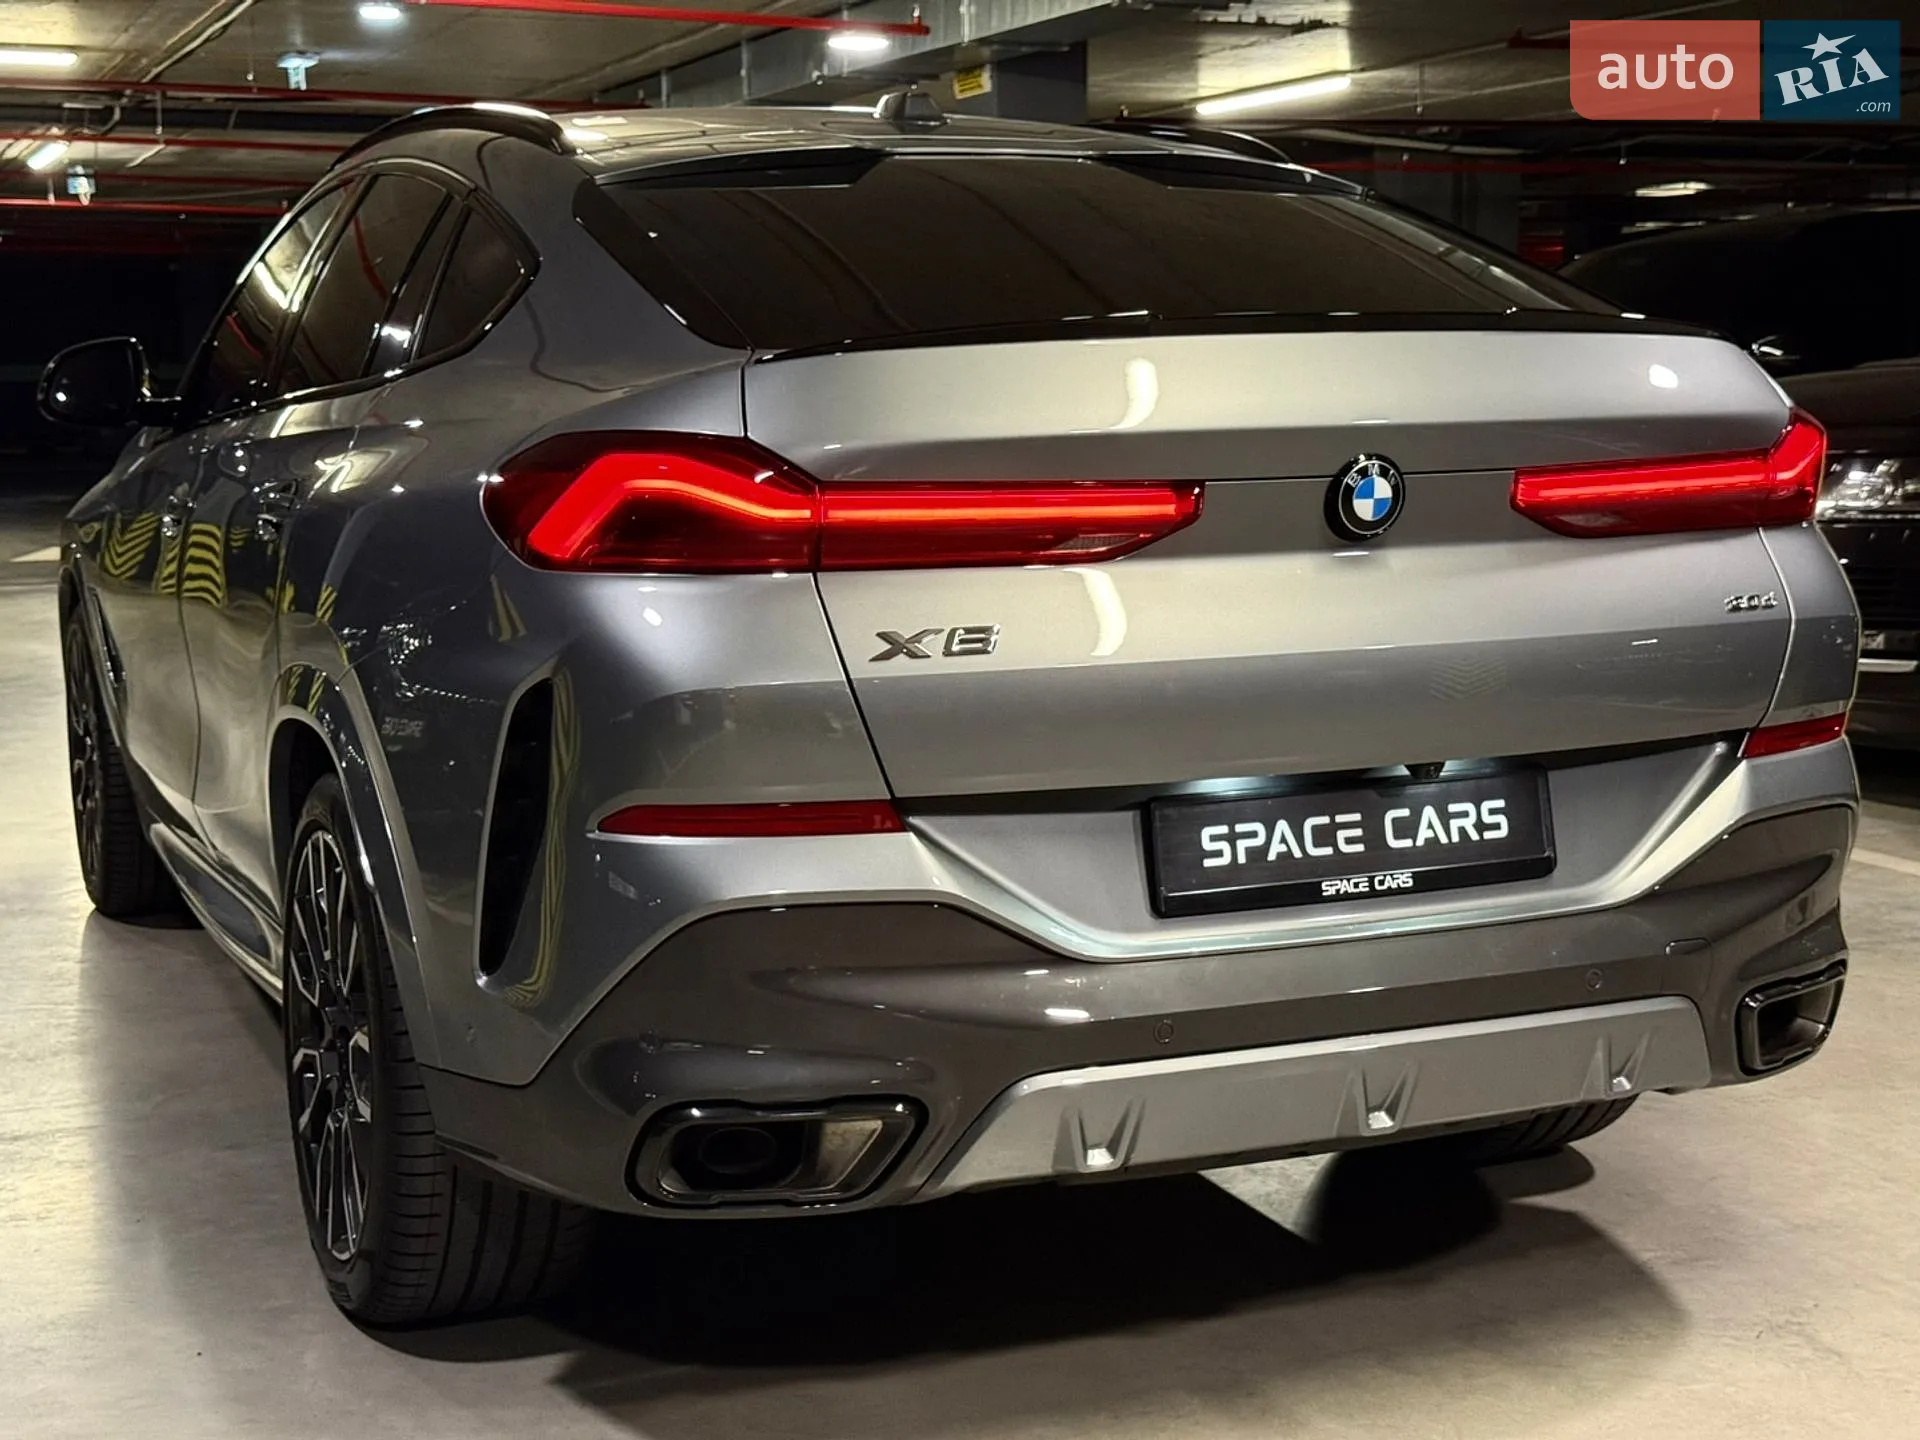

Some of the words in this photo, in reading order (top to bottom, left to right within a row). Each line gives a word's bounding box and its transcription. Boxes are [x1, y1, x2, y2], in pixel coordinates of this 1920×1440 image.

[1347, 462, 1398, 488] BMW
[868, 624, 1000, 662] X6
[1201, 812, 1366, 868] SPACE
[1384, 798, 1509, 849] CARS
[1321, 877, 1370, 896] SPACE
[1374, 872, 1413, 891] CARS
